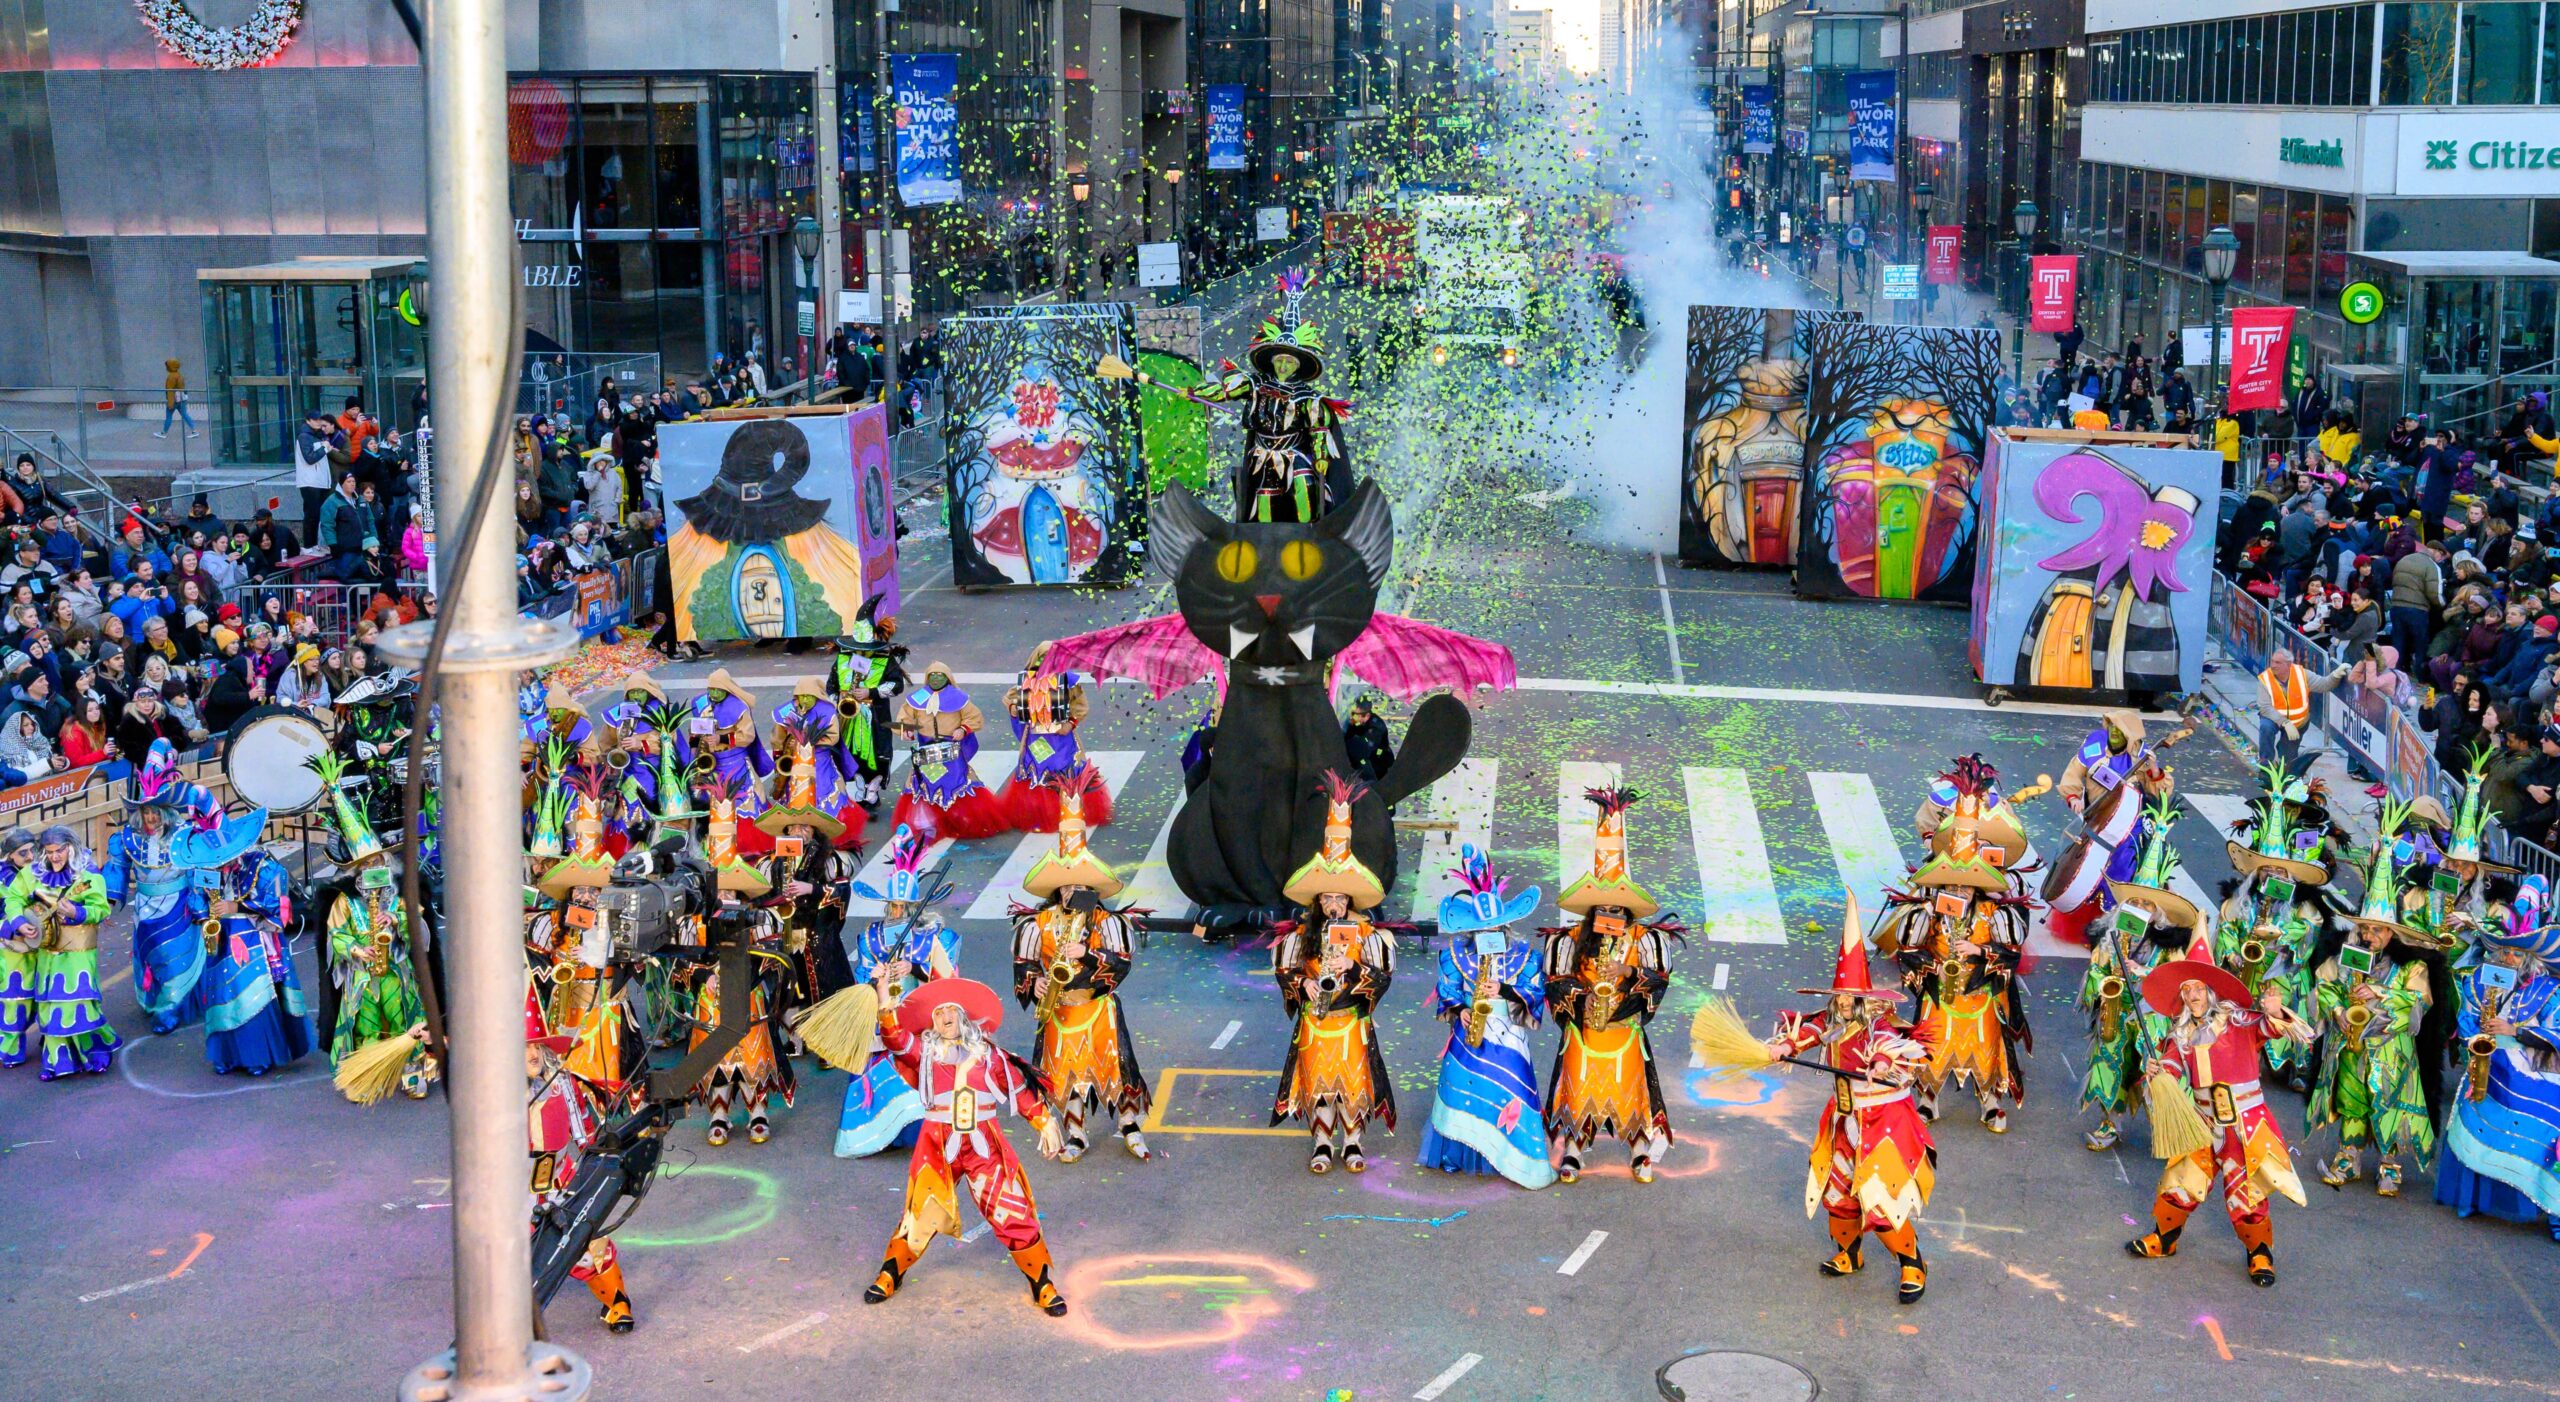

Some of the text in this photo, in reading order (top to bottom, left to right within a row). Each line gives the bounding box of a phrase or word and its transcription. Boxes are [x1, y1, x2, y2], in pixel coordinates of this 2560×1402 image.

[1210, 135, 1239, 143] PARK
[902, 144, 952, 161] PARK
[2238, 381, 2258, 390] CENTER
[2243, 386, 2265, 394] CAMPUS
[2343, 709, 2371, 753] philler
[0, 780, 76, 812] amily Night
